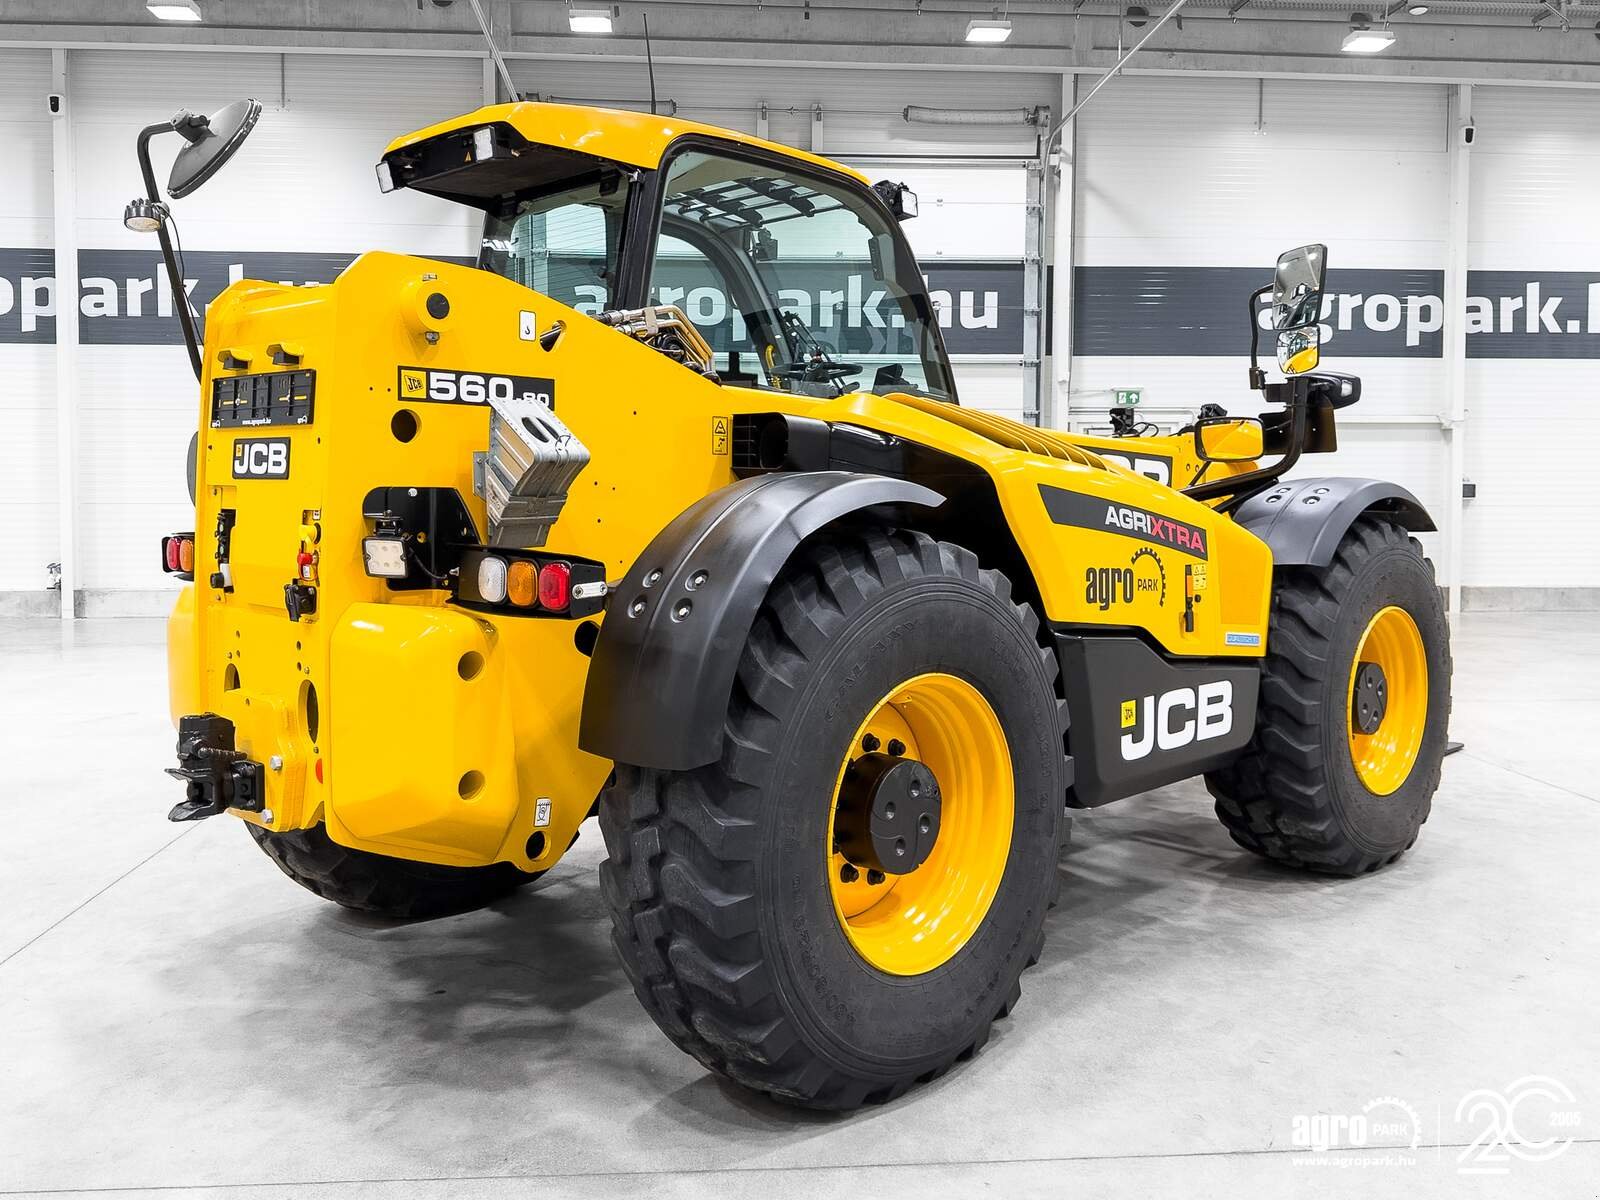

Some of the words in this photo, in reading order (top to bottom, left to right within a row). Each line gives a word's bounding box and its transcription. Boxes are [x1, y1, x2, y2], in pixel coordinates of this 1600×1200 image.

[234, 442, 287, 474] JCB
[1105, 505, 1205, 552] AGRIXTRA
[1086, 567, 1134, 611] agro
[1137, 577, 1159, 592] PARK
[1120, 680, 1233, 761] JCB
